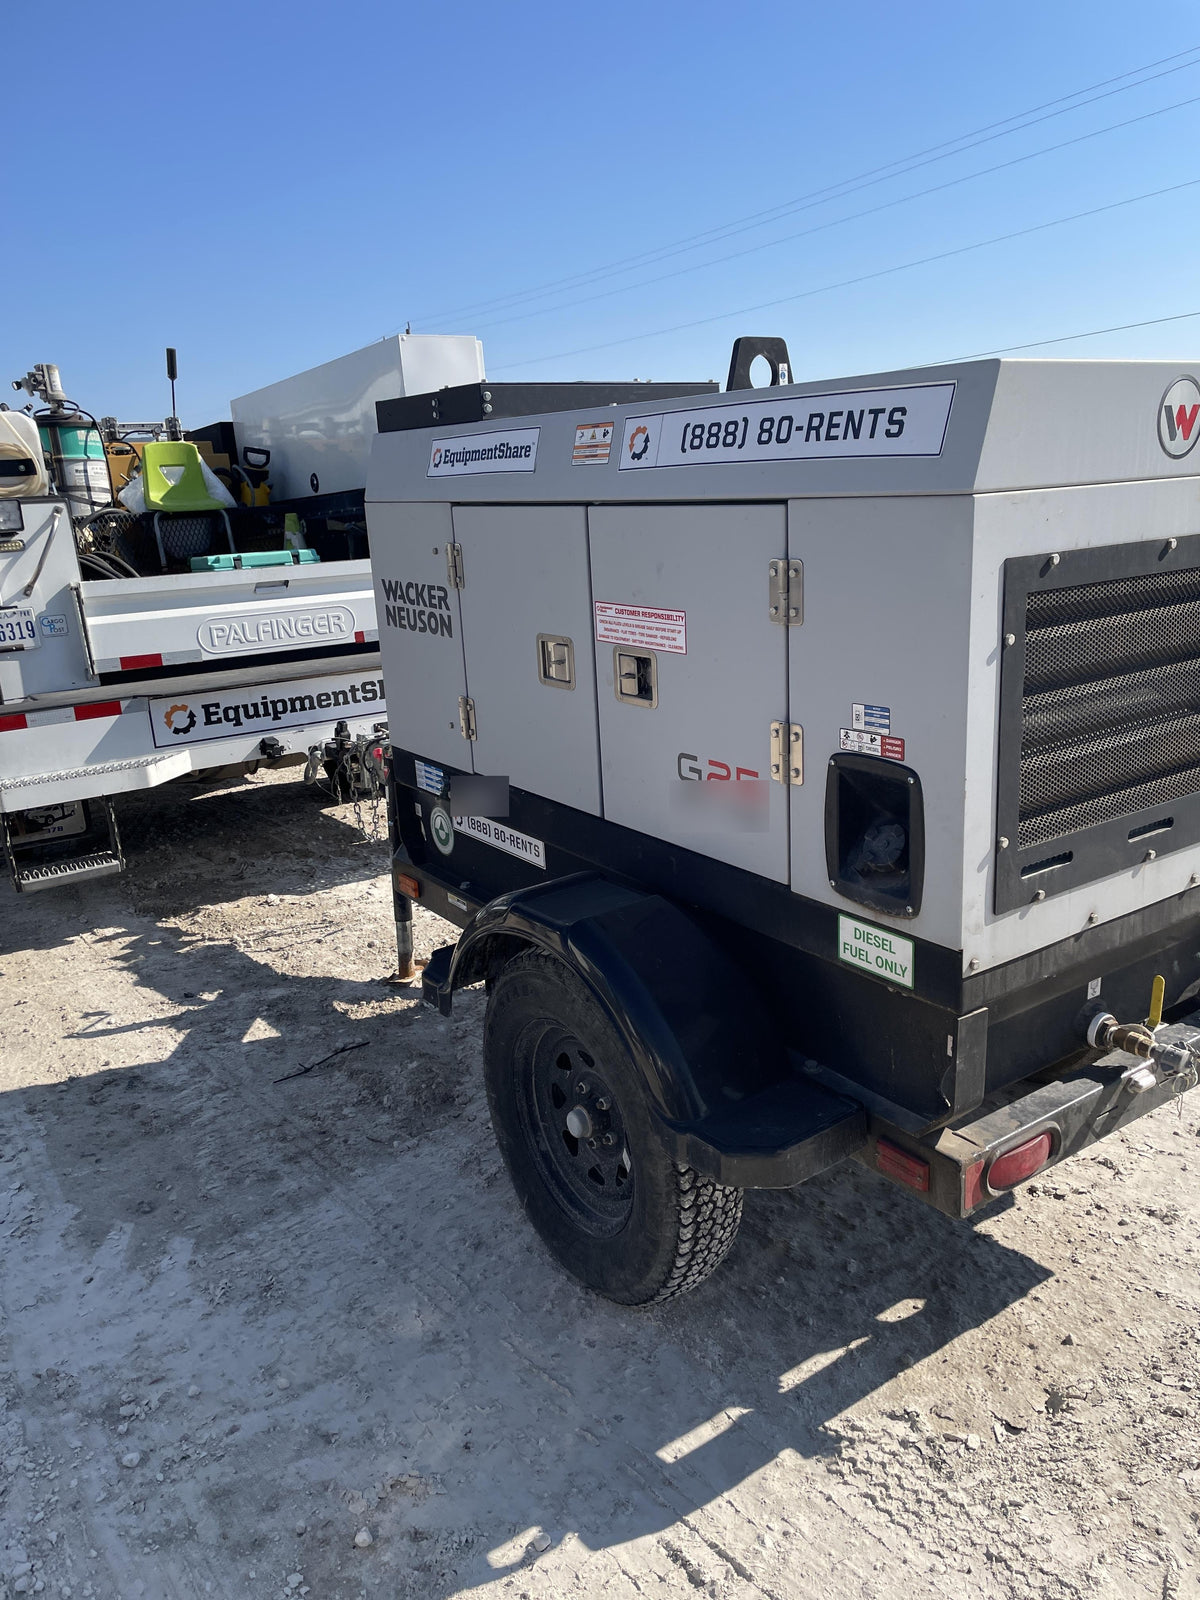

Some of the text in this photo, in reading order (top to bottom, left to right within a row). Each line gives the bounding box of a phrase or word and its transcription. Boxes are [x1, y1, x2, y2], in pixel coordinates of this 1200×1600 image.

[681, 406, 907, 453] (888) 80-RENTS
[1164, 404, 1200, 441] W
[443, 442, 532, 467] EquipmentShare
[381, 578, 451, 611] WACKER
[209, 612, 347, 647] PALFINGER
[385, 604, 453, 638] NEUSON
[614, 608, 684, 622] CUSTOMER RESPONSIBILITY
[467, 816, 491, 838] (888)
[494, 827, 540, 858] 80-RENTS
[854, 927, 896, 954] DIESEL
[843, 942, 908, 978] FUEL ONLY
